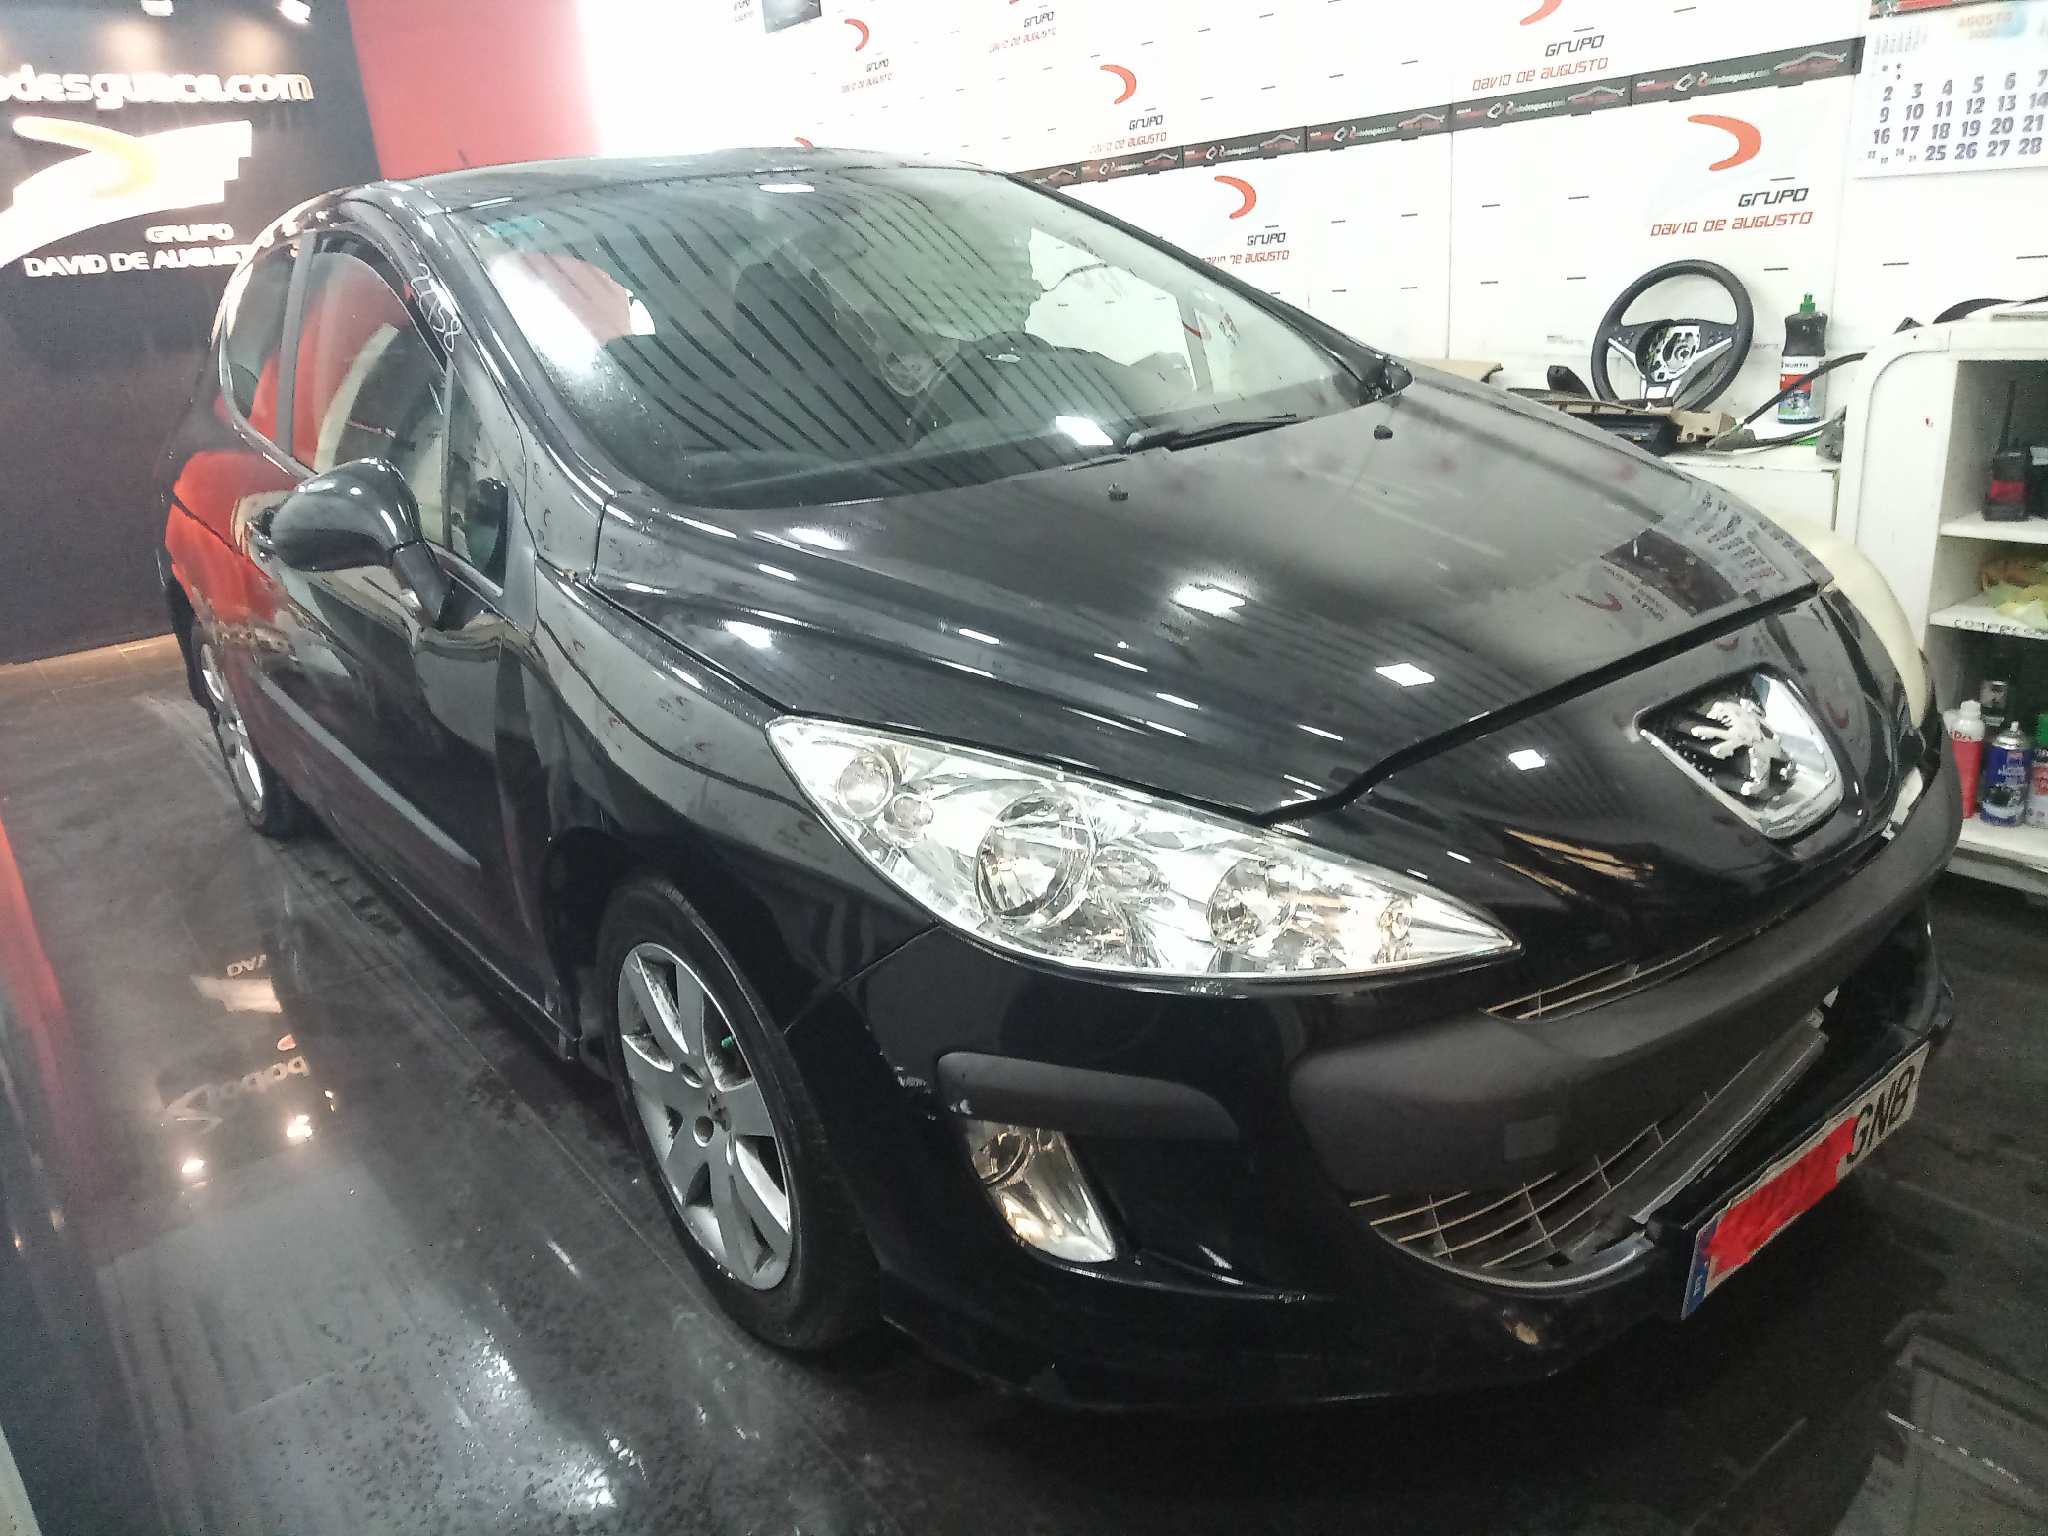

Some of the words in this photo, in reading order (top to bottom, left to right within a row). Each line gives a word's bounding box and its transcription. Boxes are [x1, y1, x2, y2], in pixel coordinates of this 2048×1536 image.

[1544, 34, 1605, 58] GRUPO
[1472, 73, 1511, 92] DAVID
[1516, 69, 1536, 84] DE
[1540, 57, 1609, 80] AUGUSTO
[1882, 86, 1894, 102] 2
[1912, 83, 1923, 99] 3
[1942, 79, 1953, 96] 4
[1972, 75, 1985, 94] 5
[2003, 72, 2017, 91] 6
[1880, 106, 1890, 124] 9
[1905, 103, 1924, 121] 10
[1936, 100, 1953, 118] 11
[1966, 96, 1986, 115] 12
[1998, 94, 2017, 113] 13
[1129, 114, 1164, 131] GRUPO
[1873, 127, 1891, 145] 16
[1902, 125, 1920, 143] 17
[1931, 122, 1951, 140] 18
[1961, 119, 1982, 138] 19
[1989, 116, 2014, 136] 20
[2022, 114, 2045, 133] 21
[1925, 144, 1947, 162] 25
[1954, 141, 1979, 161] 26
[1986, 139, 2011, 158] 27
[2018, 136, 2044, 156] 28
[1738, 187, 1810, 208] GRUPO
[145, 223, 235, 244] GRUPO
[1650, 221, 1698, 237] DAVID
[1703, 218, 1727, 233] DE
[1731, 211, 1814, 231] AUGUSTO
[1247, 232, 1287, 246] GRUPO
[23, 252, 108, 278] DAVID
[110, 251, 150, 273] DE
[1245, 250, 1290, 264] AUGUSTO
